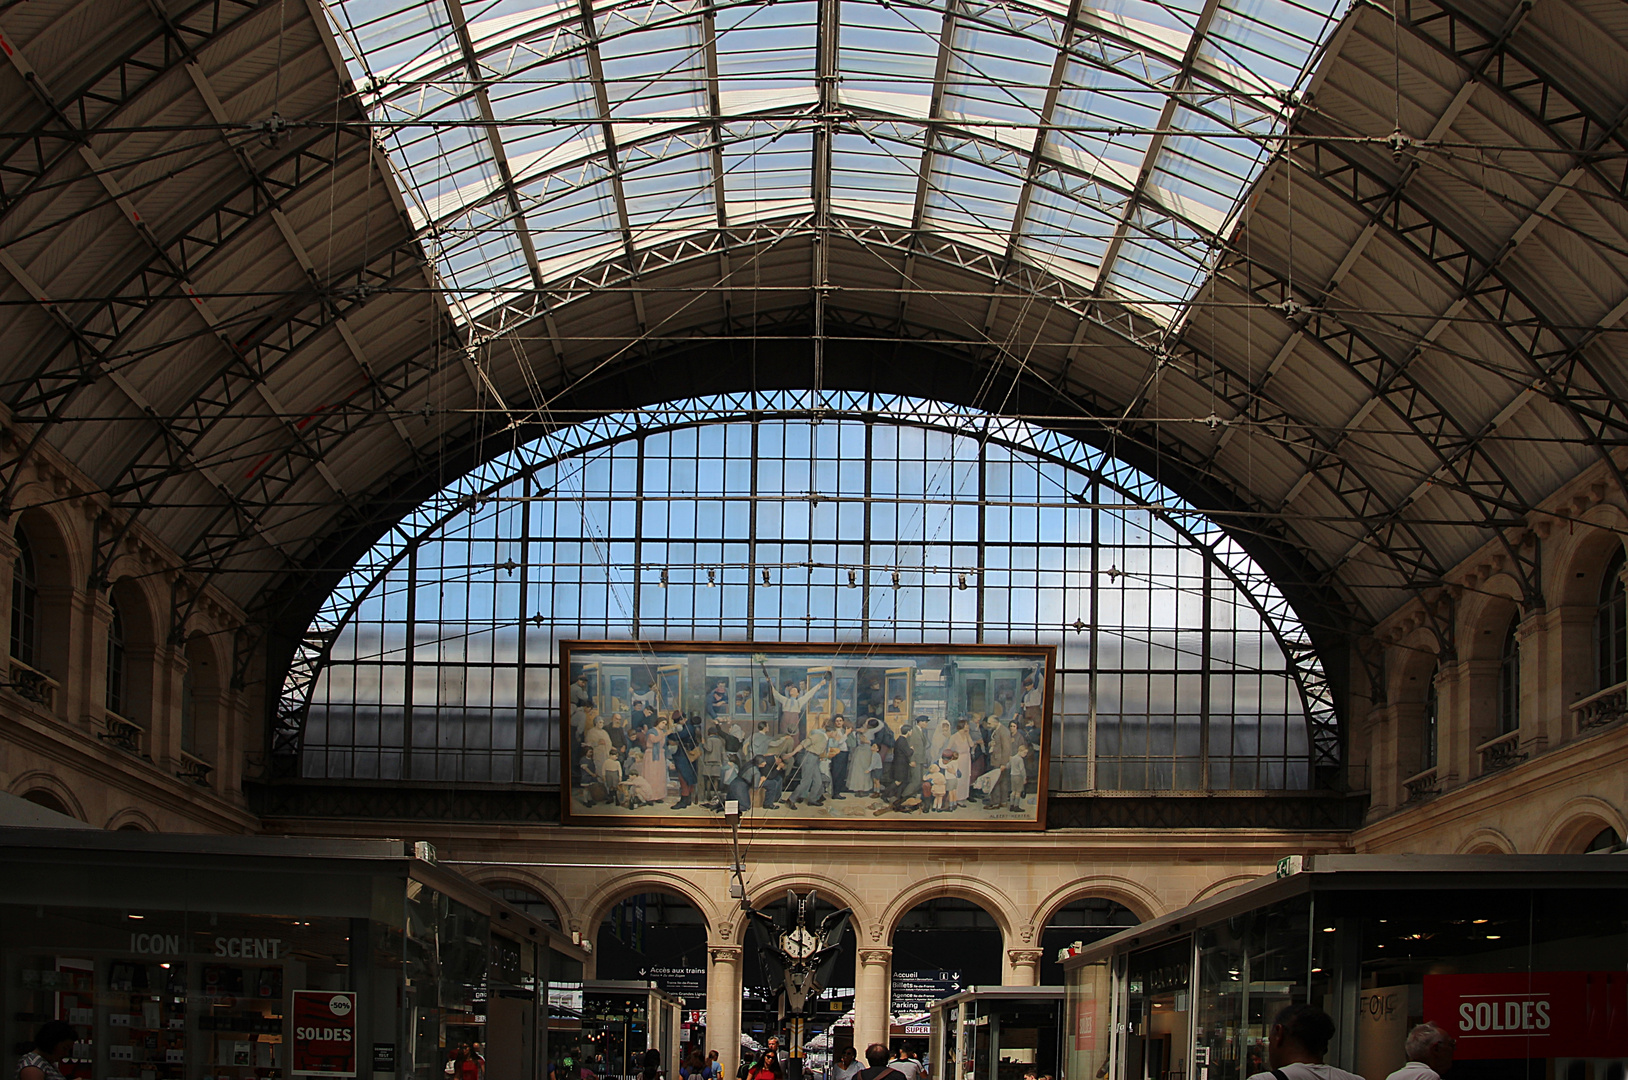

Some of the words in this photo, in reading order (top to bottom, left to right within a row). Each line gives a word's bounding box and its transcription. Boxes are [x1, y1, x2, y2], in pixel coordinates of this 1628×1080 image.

[130, 933, 179, 955] ICON
[214, 936, 281, 960] SCENT
[1458, 1000, 1551, 1032] SOLDES
[296, 1026, 352, 1042] SOLDES
